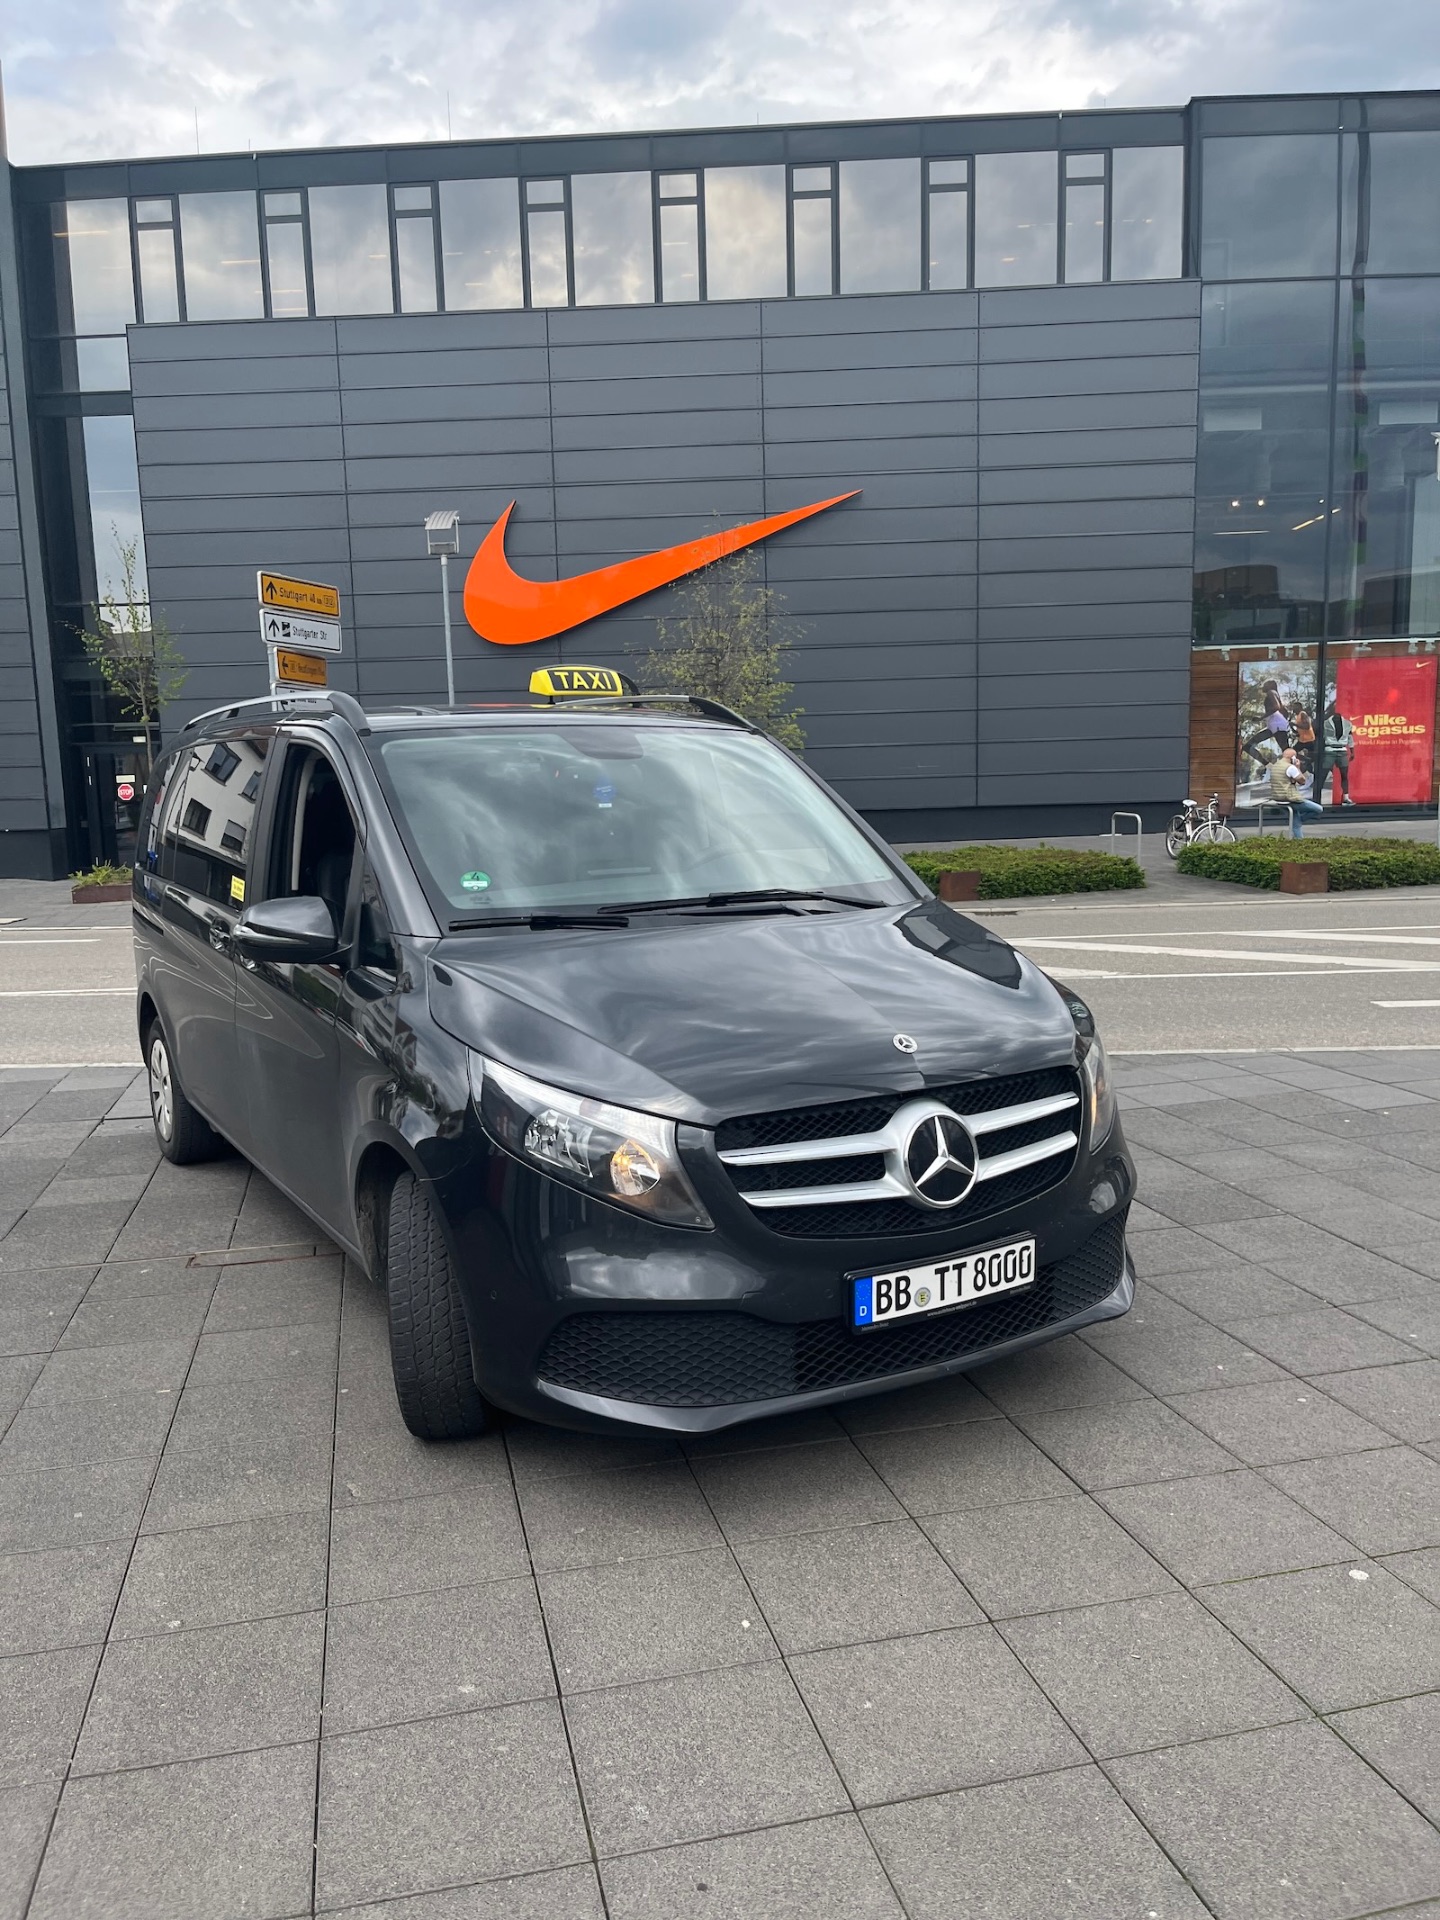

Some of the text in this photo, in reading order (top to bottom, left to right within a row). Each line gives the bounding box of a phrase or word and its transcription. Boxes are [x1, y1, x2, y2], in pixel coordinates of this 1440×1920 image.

[279, 587, 308, 603] Stuttgart
[292, 625, 319, 640] Stuttgarter
[553, 671, 612, 690] TAXI
[1364, 714, 1407, 726] Nike
[119, 788, 133, 796] STOP
[876, 1275, 911, 1316] BB
[934, 1261, 967, 1301] TT
[973, 1245, 1031, 1292] 8000
[859, 1305, 867, 1317] D
